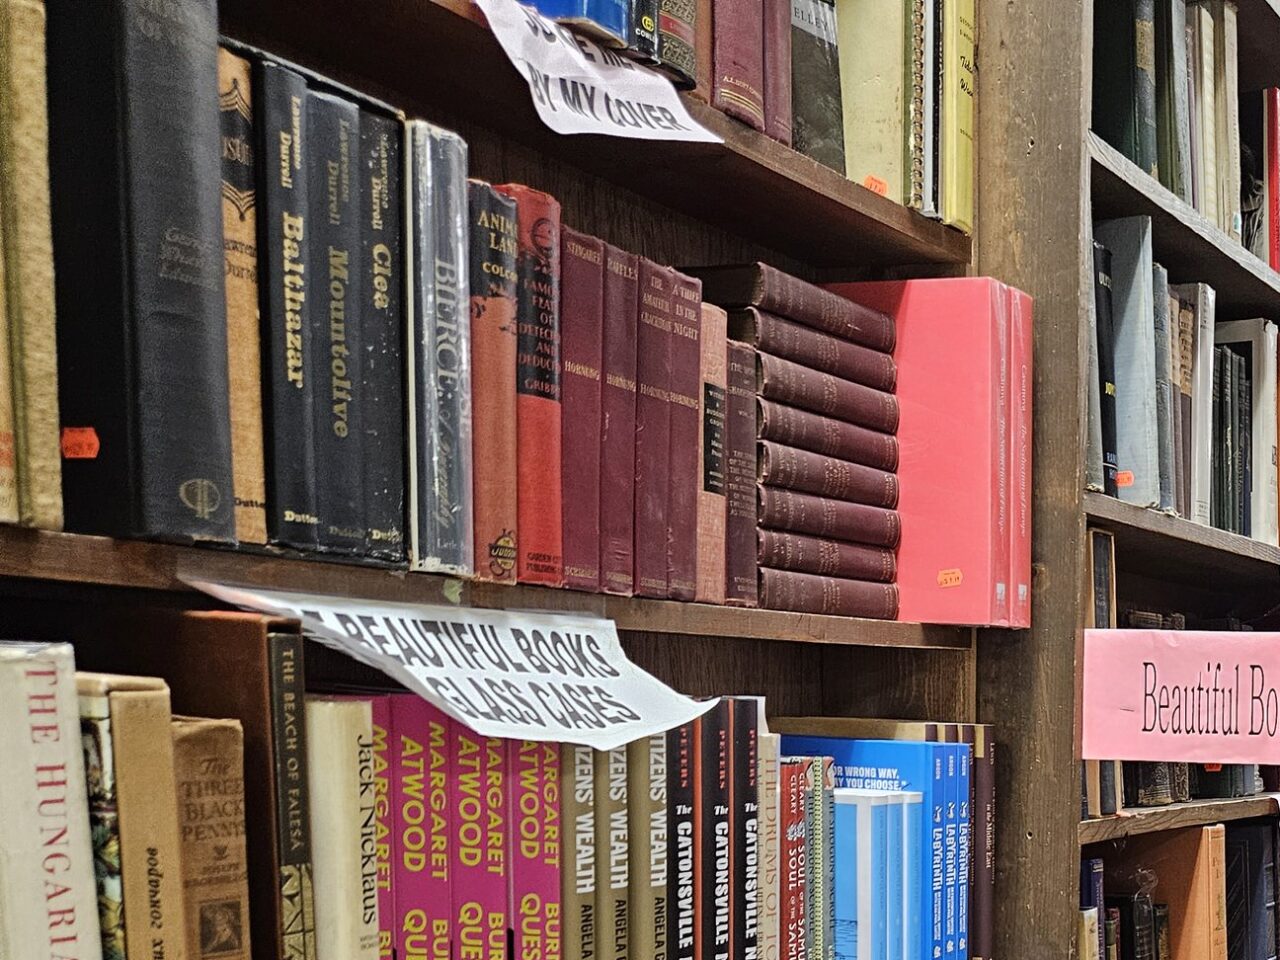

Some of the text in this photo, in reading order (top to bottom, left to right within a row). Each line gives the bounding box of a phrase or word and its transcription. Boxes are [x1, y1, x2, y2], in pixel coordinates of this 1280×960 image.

[526, 61, 692, 132] BY MY COVER
[279, 130, 293, 190] Durrell
[328, 160, 341, 226] Durrell
[283, 211, 305, 389] Balthazar
[371, 243, 392, 310] Clea
[607, 257, 638, 281] RAFFLES
[328, 247, 352, 438] Mountolive
[673, 321, 699, 341] NIGHT
[335, 613, 621, 678] BEAUTIFUL BOOKS
[25, 661, 61, 744] THE
[283, 648, 298, 748] THE BEACH
[424, 675, 642, 729] GLASS CASES
[1141, 661, 1240, 736] Beautiful
[181, 779, 243, 799] THREE
[401, 735, 426, 872] ATWOOD
[429, 721, 448, 882] MARGARET
[459, 735, 482, 867] ATWOOD
[845, 766, 900, 780] WRONG WAY.
[846, 777, 863, 788] YOU
[185, 800, 243, 821] BLACK
[357, 734, 377, 925] Jack Nicklaus
[575, 812, 595, 895] WEALTH
[610, 810, 628, 889] WEALTH
[650, 806, 667, 888] WEALTH
[765, 805, 777, 886] DRUMS
[788, 848, 797, 891] SOUL
[933, 827, 943, 892] LABYRINTH
[945, 823, 956, 886] LABYRINTH
[959, 822, 969, 885] LABYRINTH
[677, 821, 693, 949] CATONSVILLE
[714, 819, 729, 946] CATONSVILLE
[580, 904, 594, 960] ANGELA
[615, 899, 627, 953] ANGELA
[654, 897, 666, 950] ANGELA
